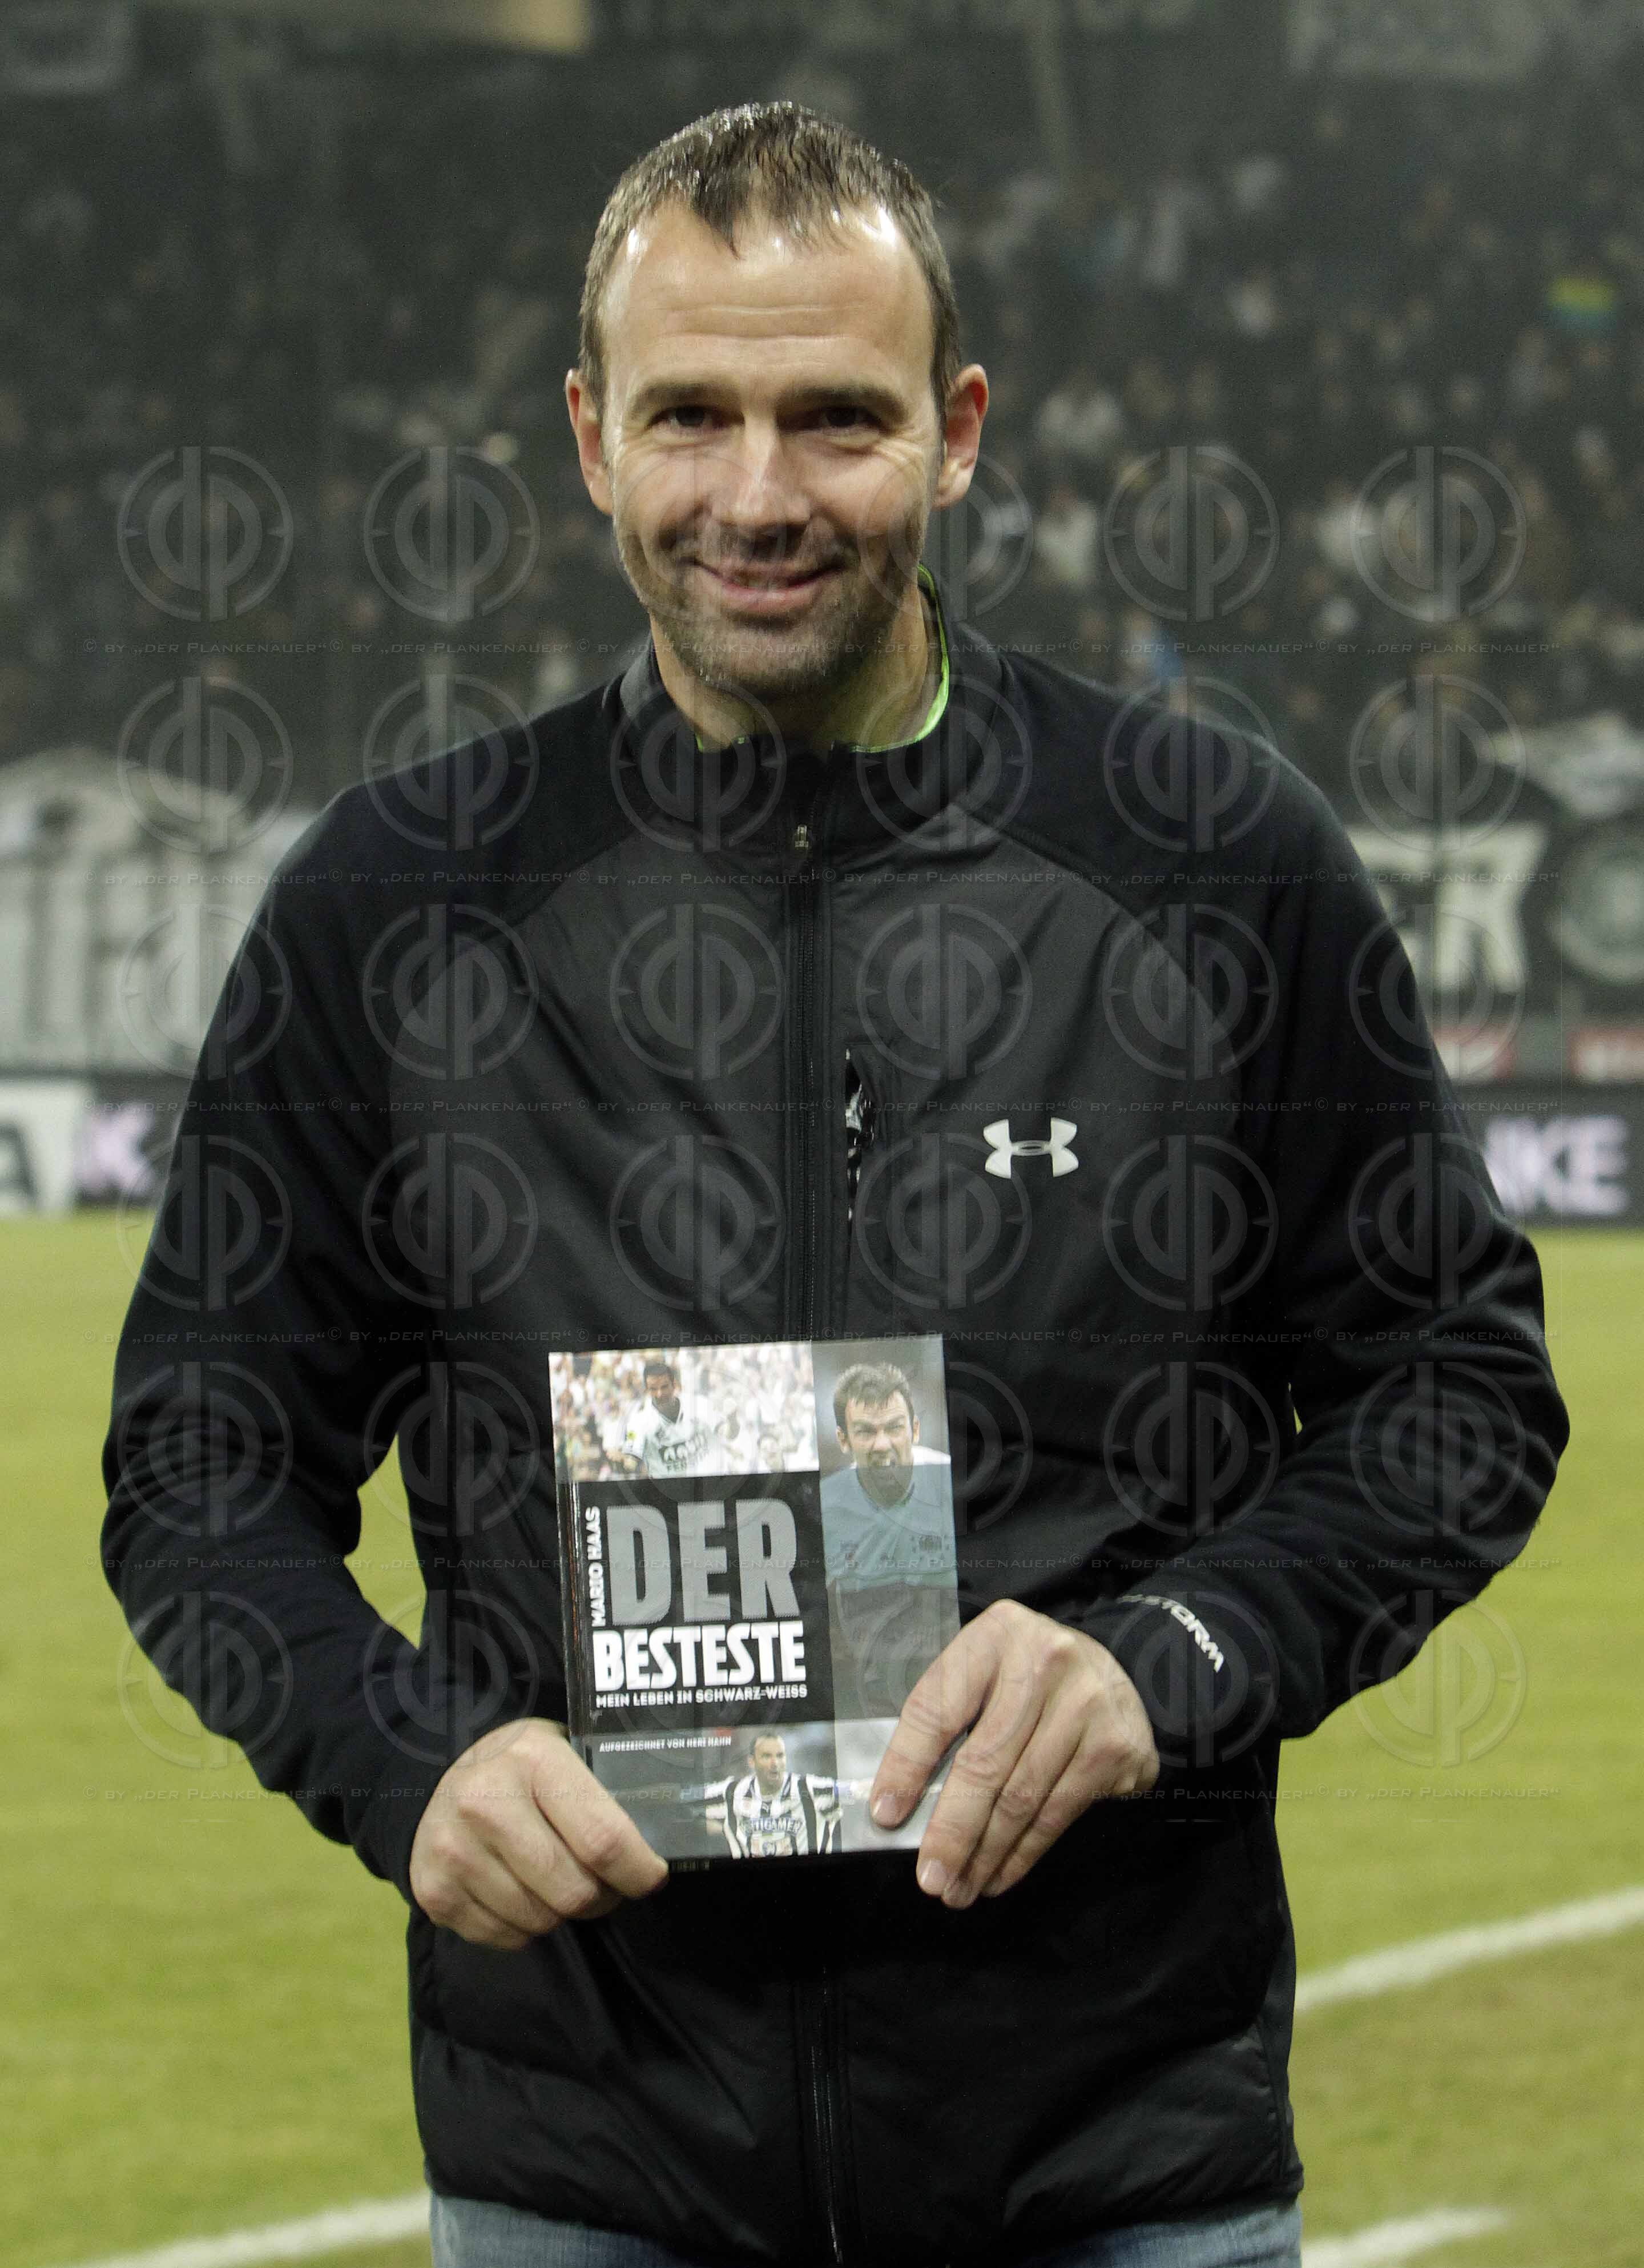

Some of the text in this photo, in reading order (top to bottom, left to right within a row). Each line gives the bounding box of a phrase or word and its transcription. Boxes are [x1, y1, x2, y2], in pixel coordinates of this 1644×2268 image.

[585, 1506, 606, 1627] MARIO HAAS
[606, 1498, 800, 1626] DER
[592, 1620, 807, 1692] BESTESTE
[596, 1684, 808, 1708] MEIN LEBEN IN SCHWARZ-WEISS
[599, 1739, 666, 1753] AUFGEZEICHNET
[667, 1738, 685, 1749] VON
